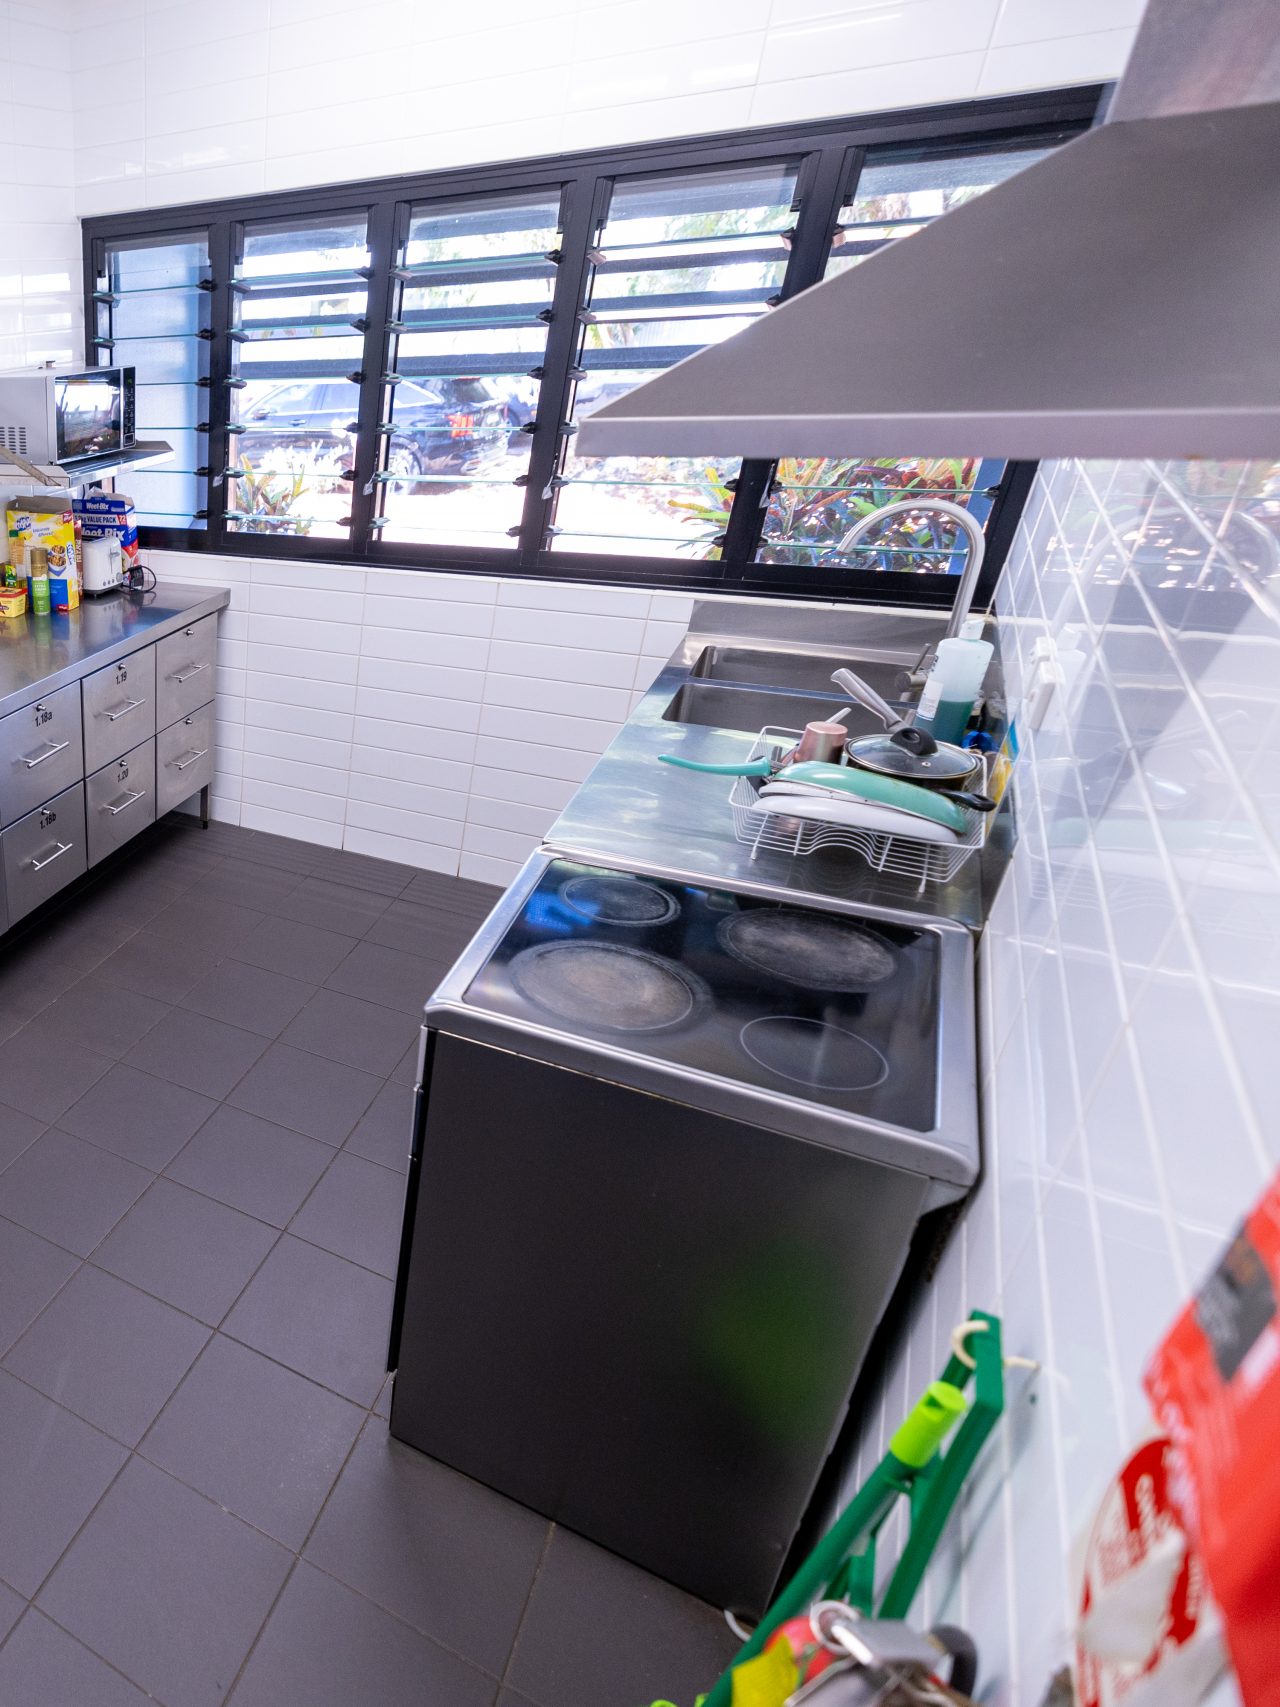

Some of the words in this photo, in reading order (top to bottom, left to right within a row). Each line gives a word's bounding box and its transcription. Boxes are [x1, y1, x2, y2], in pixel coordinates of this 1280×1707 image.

[87, 515, 102, 523] VALUE
[116, 671, 127, 685] 1.19
[35, 712, 52, 727] 1.18a
[118, 768, 128, 783] 1.20
[40, 813, 56, 829] 1.18b
